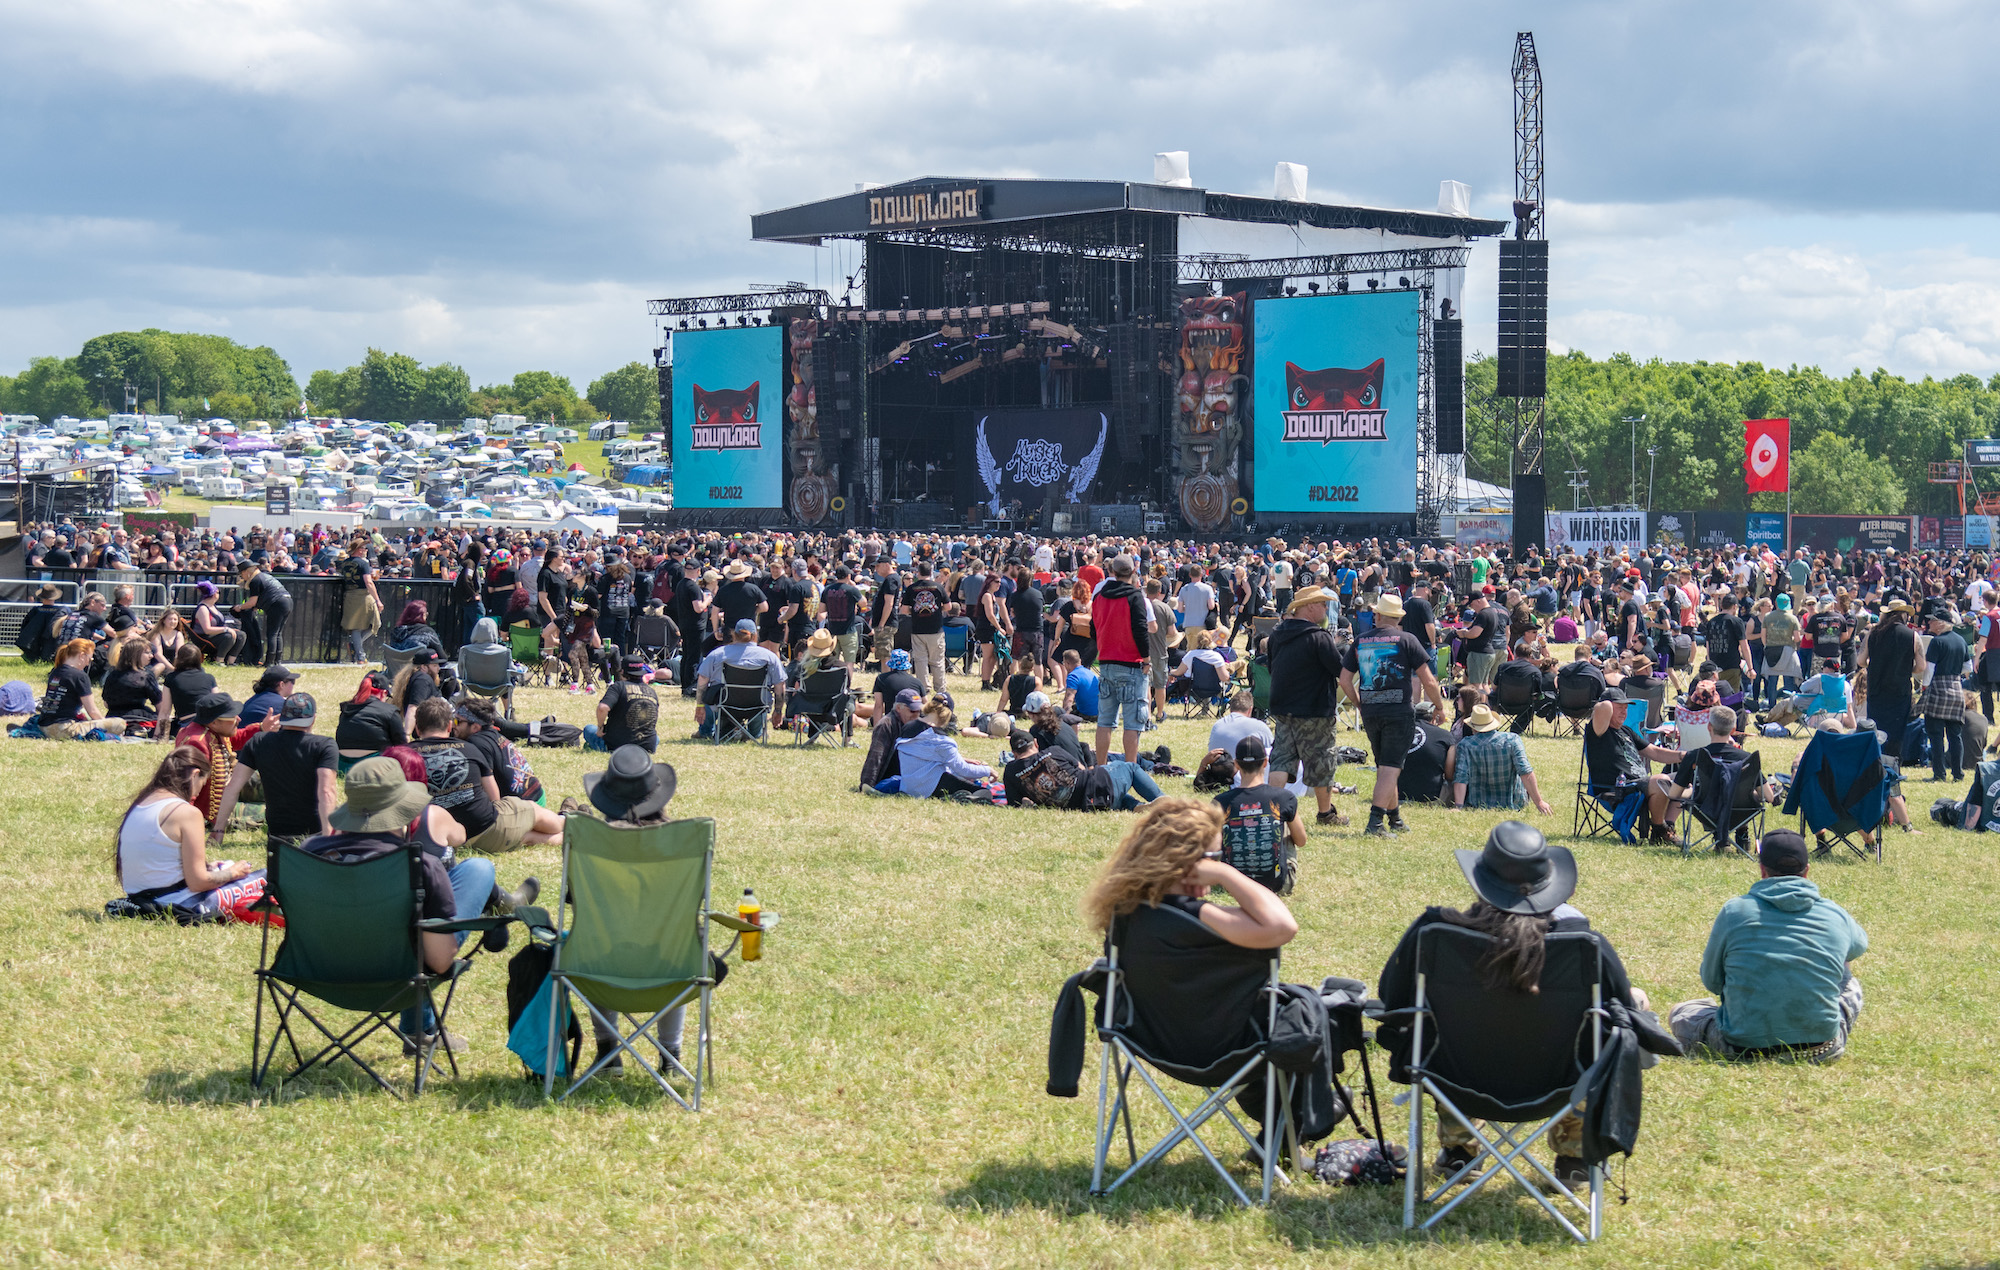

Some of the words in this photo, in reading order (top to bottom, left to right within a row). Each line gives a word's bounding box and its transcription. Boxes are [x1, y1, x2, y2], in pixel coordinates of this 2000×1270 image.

[869, 189, 978, 225] DOWNLOAD
[1284, 411, 1385, 440] DOWNLOAD
[692, 425, 761, 449] DOWNLOAD
[1976, 445, 2000, 453] DRINKIN
[1979, 454, 2000, 462] WATER
[709, 485, 743, 499] #DL2022
[1308, 485, 1359, 502] #DL2022
[1458, 520, 1472, 530] IRON
[1472, 520, 1498, 529] MAIDEN
[1569, 517, 1640, 542] WARGASM
[1859, 520, 1880, 532] ALTER
[1881, 520, 1907, 533] BRIDGE
[1747, 530, 1782, 541] Spiritbox
